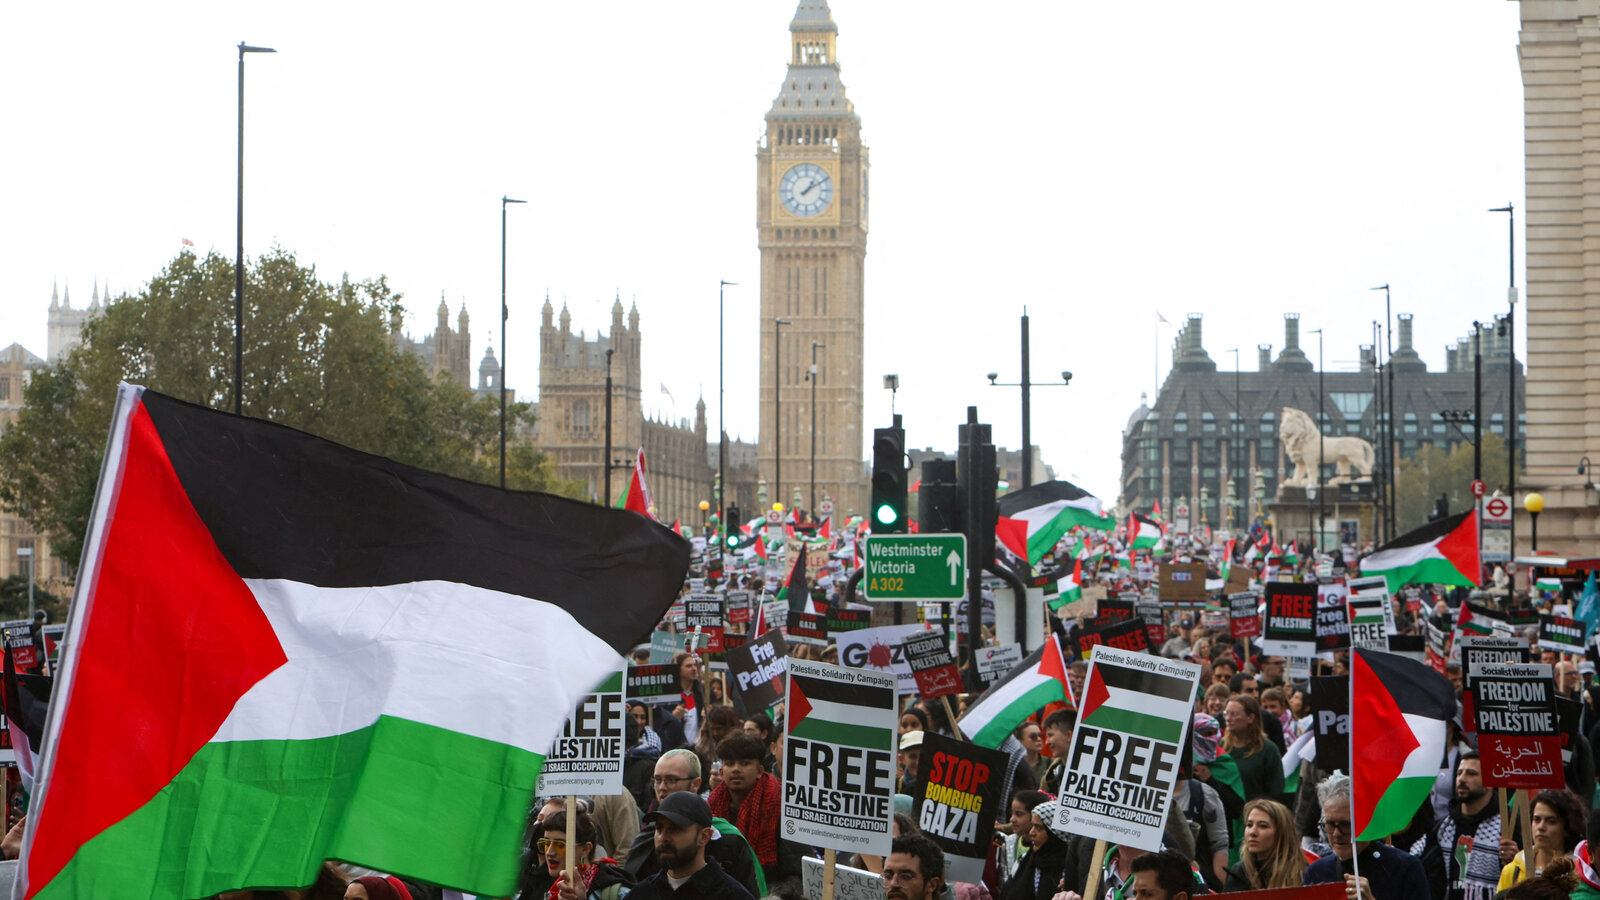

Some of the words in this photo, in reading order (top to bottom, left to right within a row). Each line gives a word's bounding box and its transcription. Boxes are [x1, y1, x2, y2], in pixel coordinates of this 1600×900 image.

[1474, 482, 1483, 495] E
[870, 543, 943, 557] Westminster
[870, 561, 916, 574] Victoria
[870, 577, 904, 591] A302
[688, 602, 720, 612] FREEDOM
[1271, 594, 1313, 619] FREE
[688, 616, 722, 626] PALESTINE
[1269, 617, 1312, 630] PALESTINE
[1351, 623, 1385, 640] FREE
[906, 637, 945, 656] FREEDOM
[1080, 632, 1103, 652] STO
[1107, 629, 1149, 652] FREE
[749, 641, 776, 664] Free
[911, 652, 952, 671] PALESTINE
[736, 654, 789, 692] Palestin
[790, 664, 820, 676] Palestine
[822, 668, 856, 683] Solidarity
[857, 673, 894, 687] Campaign
[1095, 651, 1125, 665] Palestine
[1125, 656, 1158, 671] Solidarity
[1158, 663, 1196, 679] Campaign
[1481, 667, 1512, 676] Socialist
[1512, 667, 1540, 676] Worker
[628, 674, 674, 687] BOMBING
[1479, 681, 1546, 702] FREEDOM
[1508, 702, 1519, 711] for
[1479, 711, 1554, 732] PALESTINE
[549, 738, 621, 759] LESTINE
[1069, 725, 1178, 790] FREE
[1496, 739, 1543, 760] الحرية
[549, 762, 570, 772] ISRAELI
[572, 761, 619, 772] OCCUPATION
[786, 737, 891, 796] FREE
[929, 751, 990, 794] STOP
[1492, 760, 1553, 778] لفلسطين
[785, 782, 889, 819] PALESTINE
[925, 781, 983, 813] BOMBING
[1064, 771, 1168, 813] PALESTINE
[785, 806, 800, 818] END
[801, 809, 832, 825] ISRAELI
[833, 816, 887, 832] OCCUPATION
[919, 798, 979, 845] GAZA
[1062, 796, 1078, 809] END
[1078, 800, 1108, 814] ISRAELI
[1108, 806, 1160, 827] OCCUPATION
[798, 826, 870, 844] www.palestinecampaign.org
[1073, 816, 1141, 837] www.palestinecampaign.org
